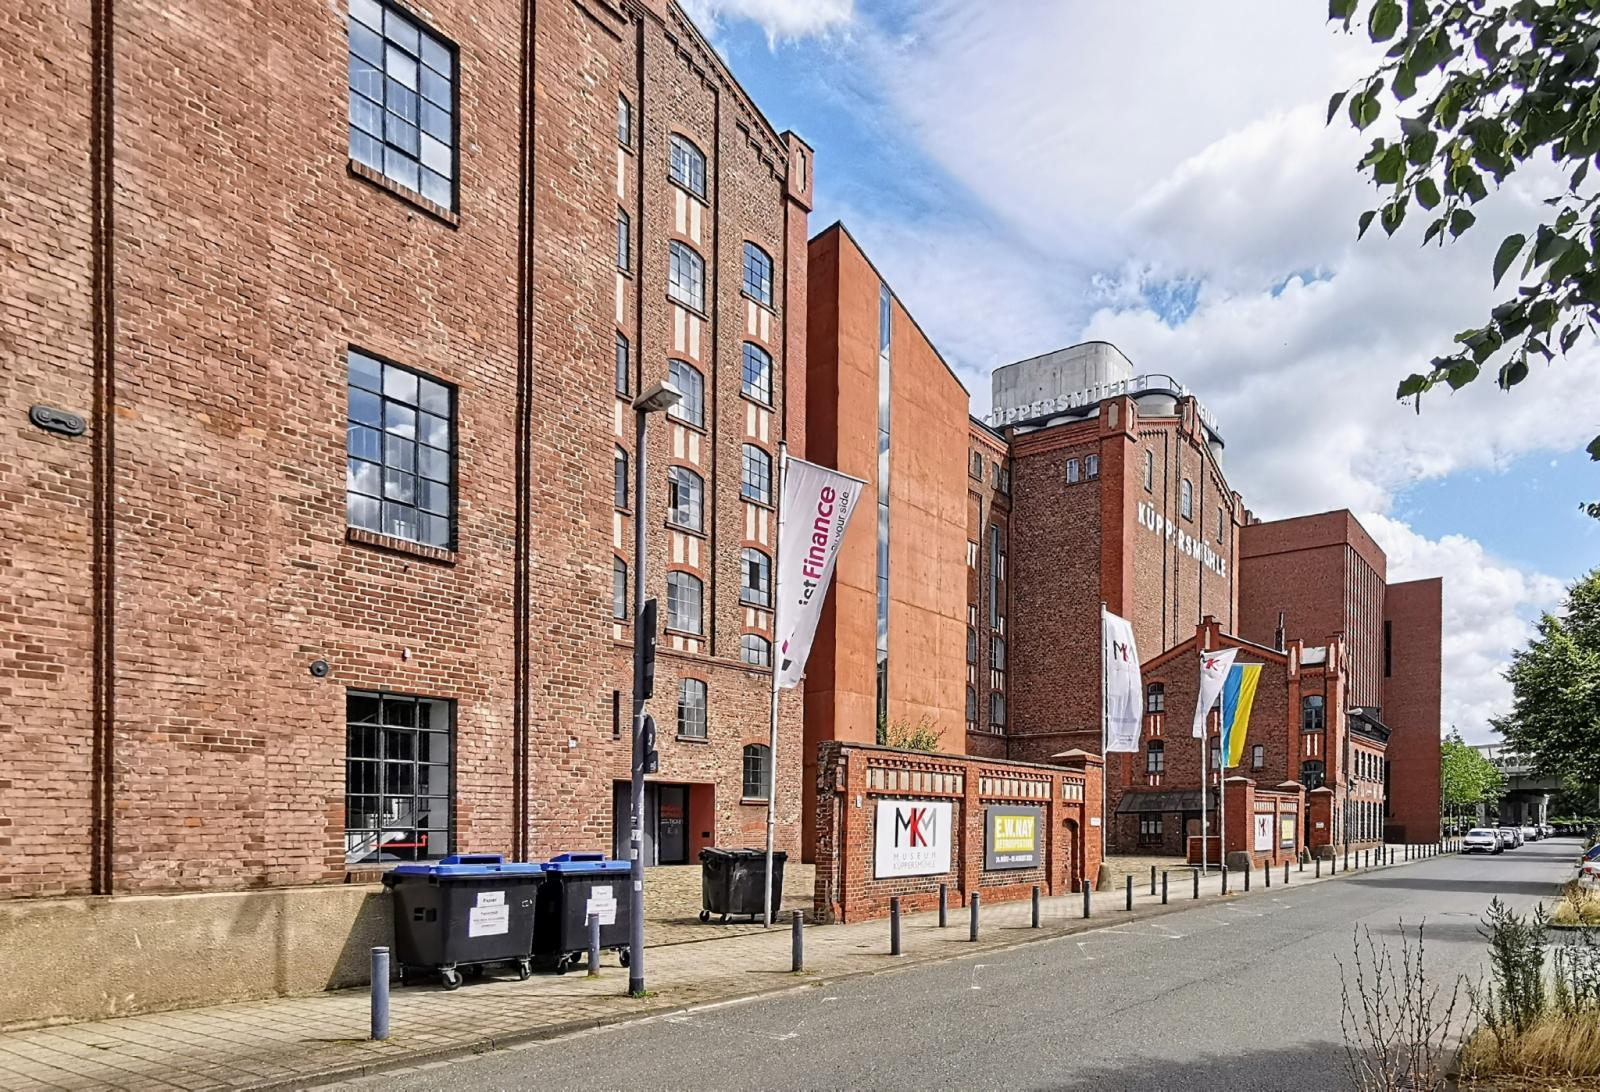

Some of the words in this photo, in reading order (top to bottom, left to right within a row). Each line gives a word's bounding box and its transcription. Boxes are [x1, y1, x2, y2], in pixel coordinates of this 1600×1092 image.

[839, 491, 849, 513] side
[894, 807, 937, 848] MKM
[893, 852, 936, 861] MUSEUM
